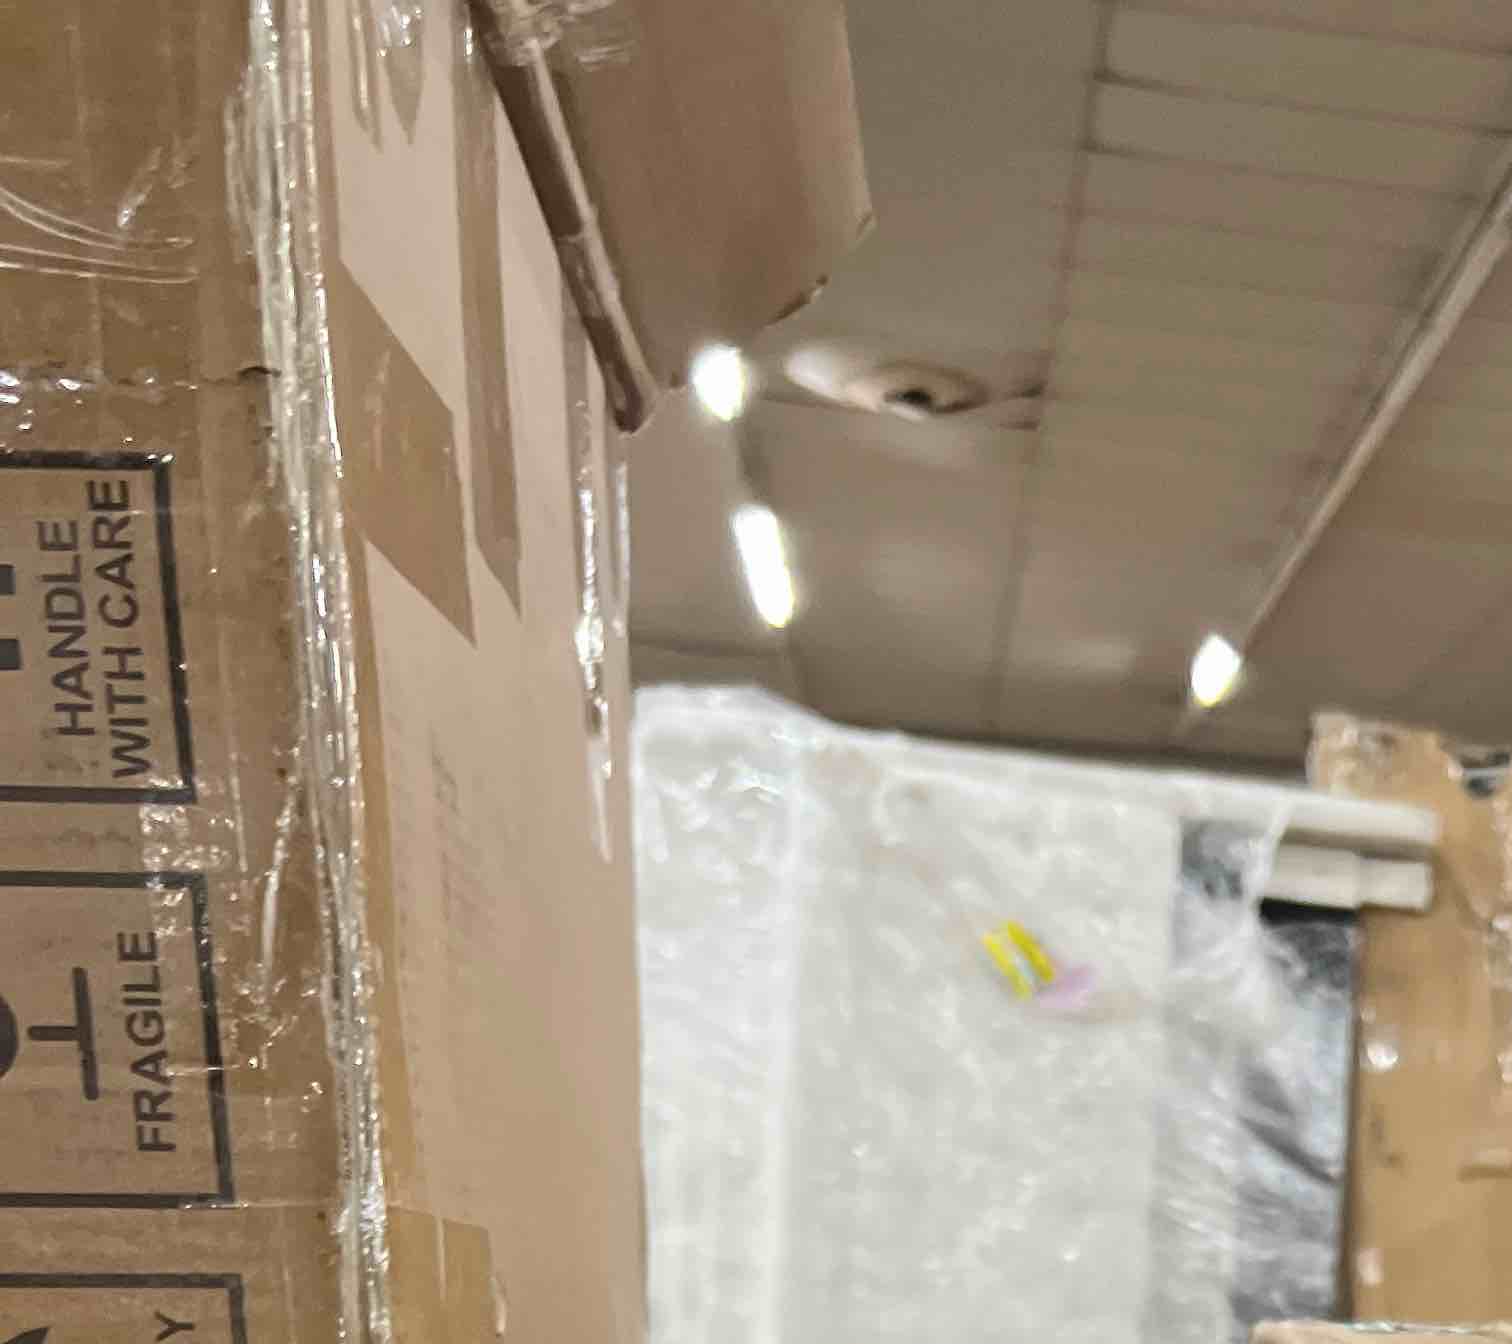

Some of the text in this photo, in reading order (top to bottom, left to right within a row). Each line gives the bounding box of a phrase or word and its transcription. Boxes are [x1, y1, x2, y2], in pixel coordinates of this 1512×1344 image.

[37, 519, 95, 737] HANDLE
[88, 478, 153, 779] WITH CARE
[117, 931, 178, 1153] FRAGILE
